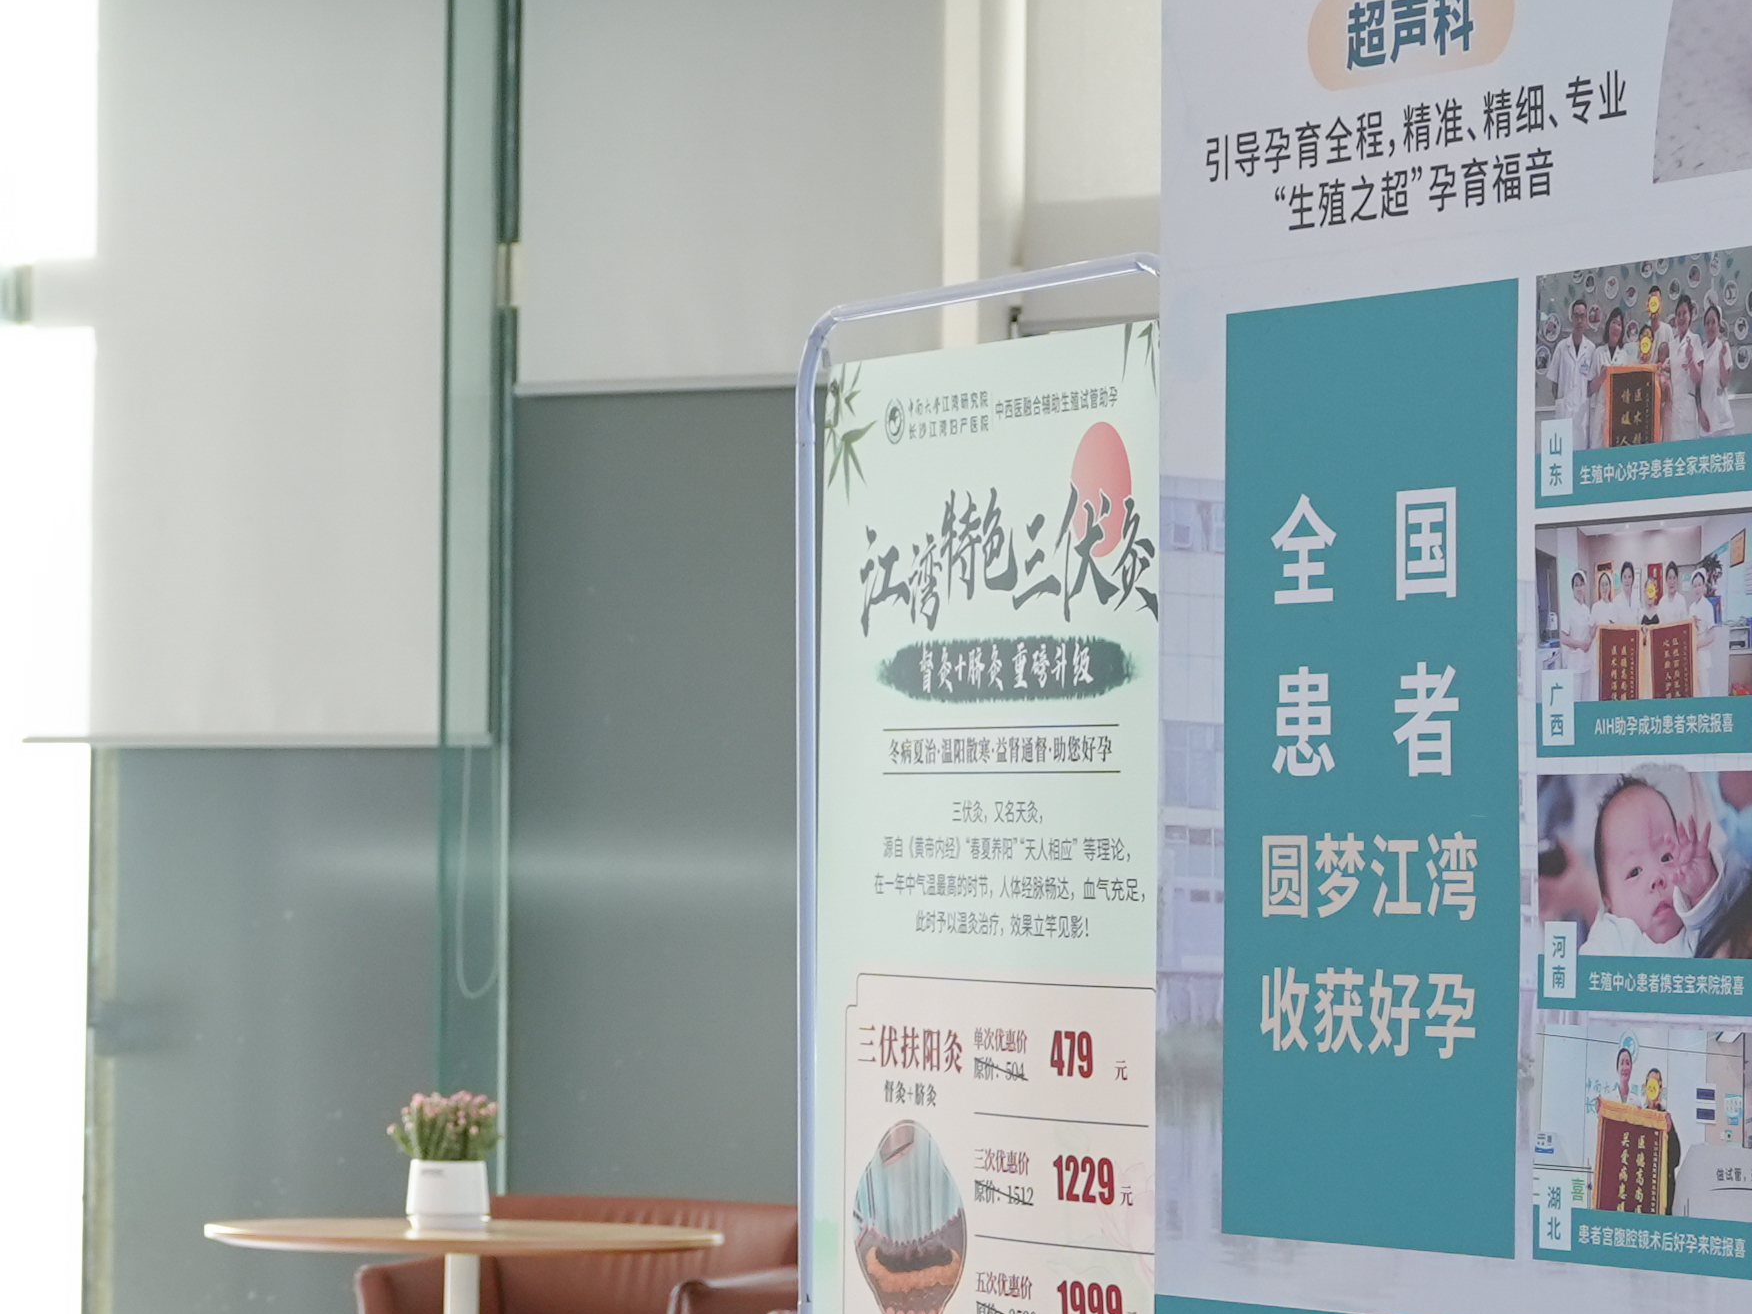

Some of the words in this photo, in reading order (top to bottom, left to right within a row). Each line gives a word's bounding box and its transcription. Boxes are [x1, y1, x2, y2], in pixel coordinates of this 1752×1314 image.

[995, 386, 1118, 421] 中西医融合辅助生殖试管助孕
[1548, 433, 1562, 487] 山东
[859, 483, 1159, 637] 江湾特色三伏灸
[1271, 486, 1457, 605] 全国
[919, 646, 1003, 693] 督灸+脐灸
[1012, 641, 1094, 689] 重磅升级
[1272, 662, 1460, 778] 患者
[1550, 683, 1564, 737] 广西
[1261, 831, 1478, 921] 圆梦江湾
[1552, 935, 1566, 989] 河南
[1260, 967, 1476, 1060] 收获好孕
[858, 1024, 963, 1075] 三伏扶阳灸
[974, 1027, 1028, 1055] 单次优惠价
[1050, 1030, 1094, 1079] 479
[1115, 1060, 1129, 1082] 元
[974, 1149, 1030, 1177] 三次优惠价
[1053, 1155, 1115, 1206] 1229
[1120, 1184, 1134, 1208] 元
[1546, 1187, 1561, 1239] 湖北
[976, 1270, 1032, 1300] 五次优惠价
